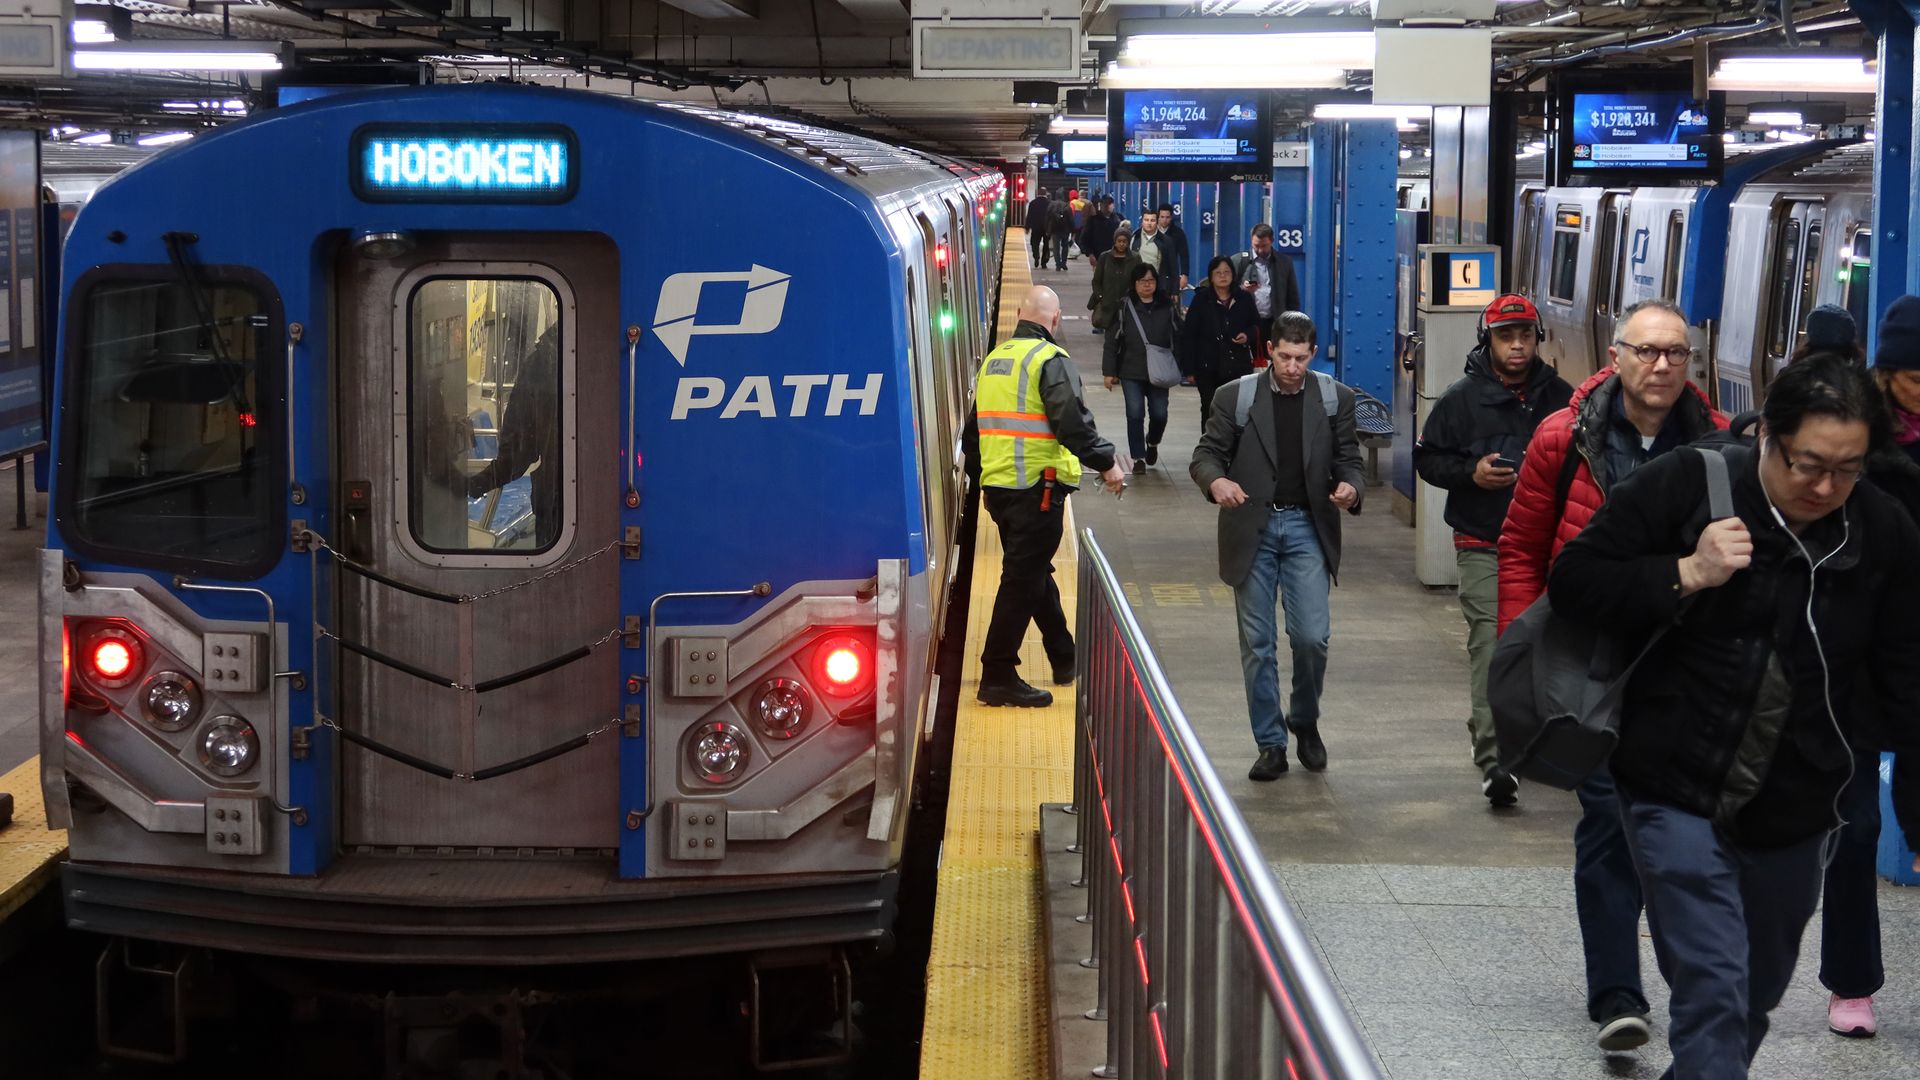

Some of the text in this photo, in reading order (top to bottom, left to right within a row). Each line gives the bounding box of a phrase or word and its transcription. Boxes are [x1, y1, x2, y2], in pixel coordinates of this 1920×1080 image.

[930, 37, 1062, 60] DEPARTING
[1228, 104, 1241, 117] 4
[1678, 109, 1692, 122] 4
[1177, 139, 1201, 147] Square
[1292, 150, 1299, 159] 2
[373, 143, 560, 183] HOBOKEN
[1680, 179, 1698, 187] TRACK
[1279, 229, 1303, 248] 33
[670, 373, 884, 420] PATH
